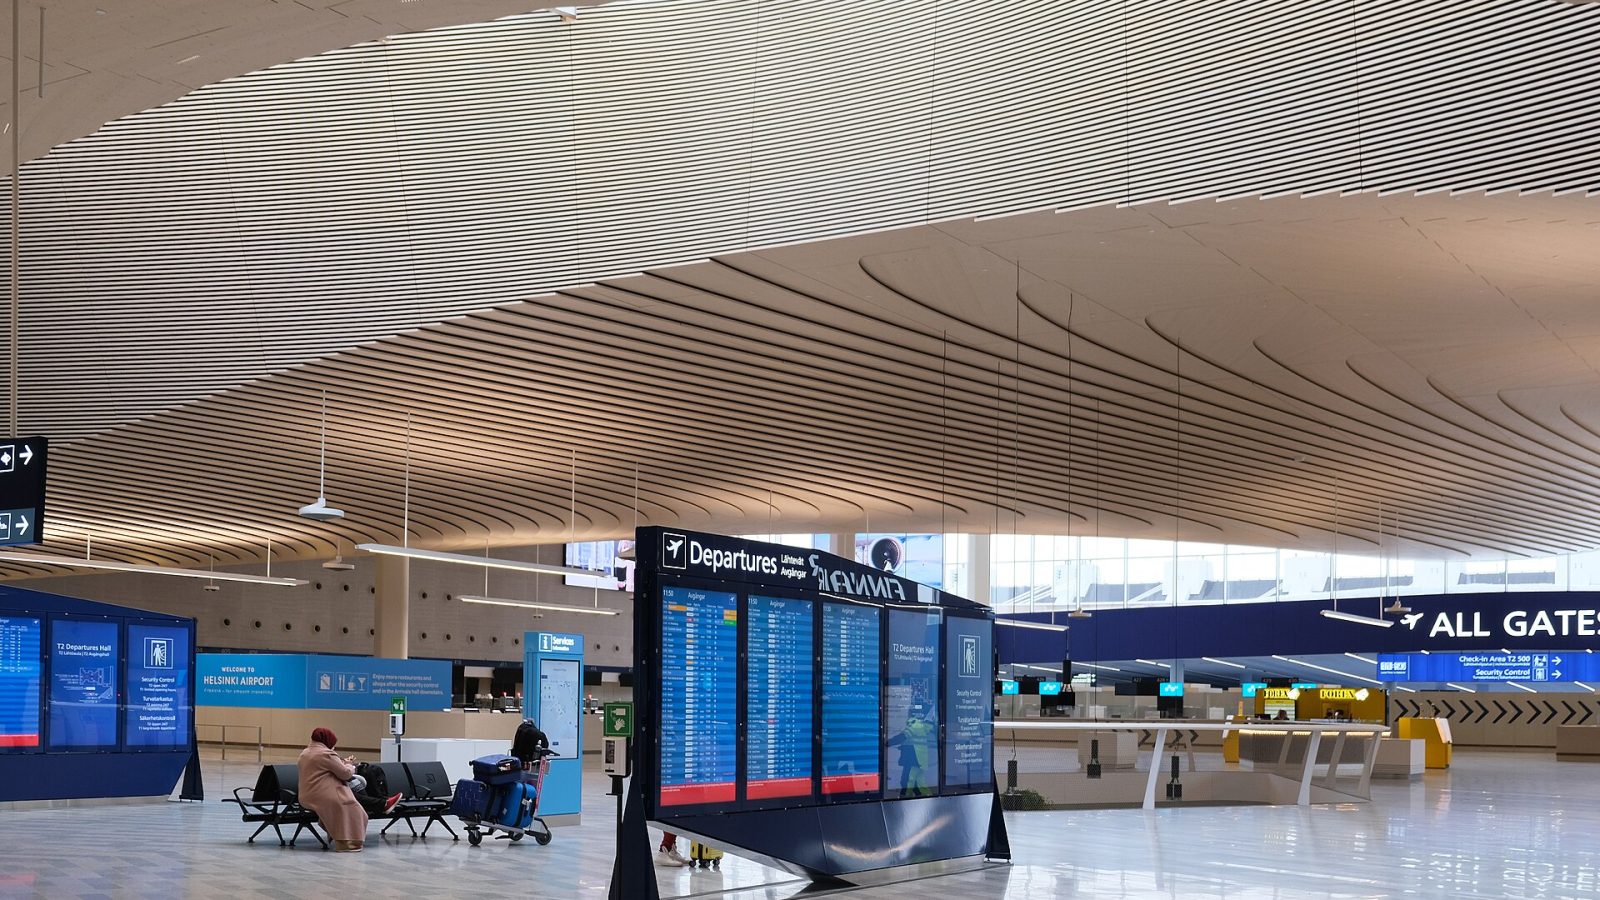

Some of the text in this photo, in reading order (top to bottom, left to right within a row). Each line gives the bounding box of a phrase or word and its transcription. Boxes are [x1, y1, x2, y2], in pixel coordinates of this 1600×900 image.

[690, 540, 777, 574] Departures
[780, 554, 804, 566] Lähtevät
[780, 566, 807, 580] Avgångar
[1429, 609, 1600, 638] ALL GATE
[552, 636, 574, 646] Services
[892, 643, 899, 651] T2
[900, 644, 925, 654] Departures
[1475, 669, 1503, 677] Security
[203, 675, 274, 686] HELSINKI AIRPORT
[1263, 688, 1289, 699] FOREX
[1320, 688, 1356, 700] FOREX
